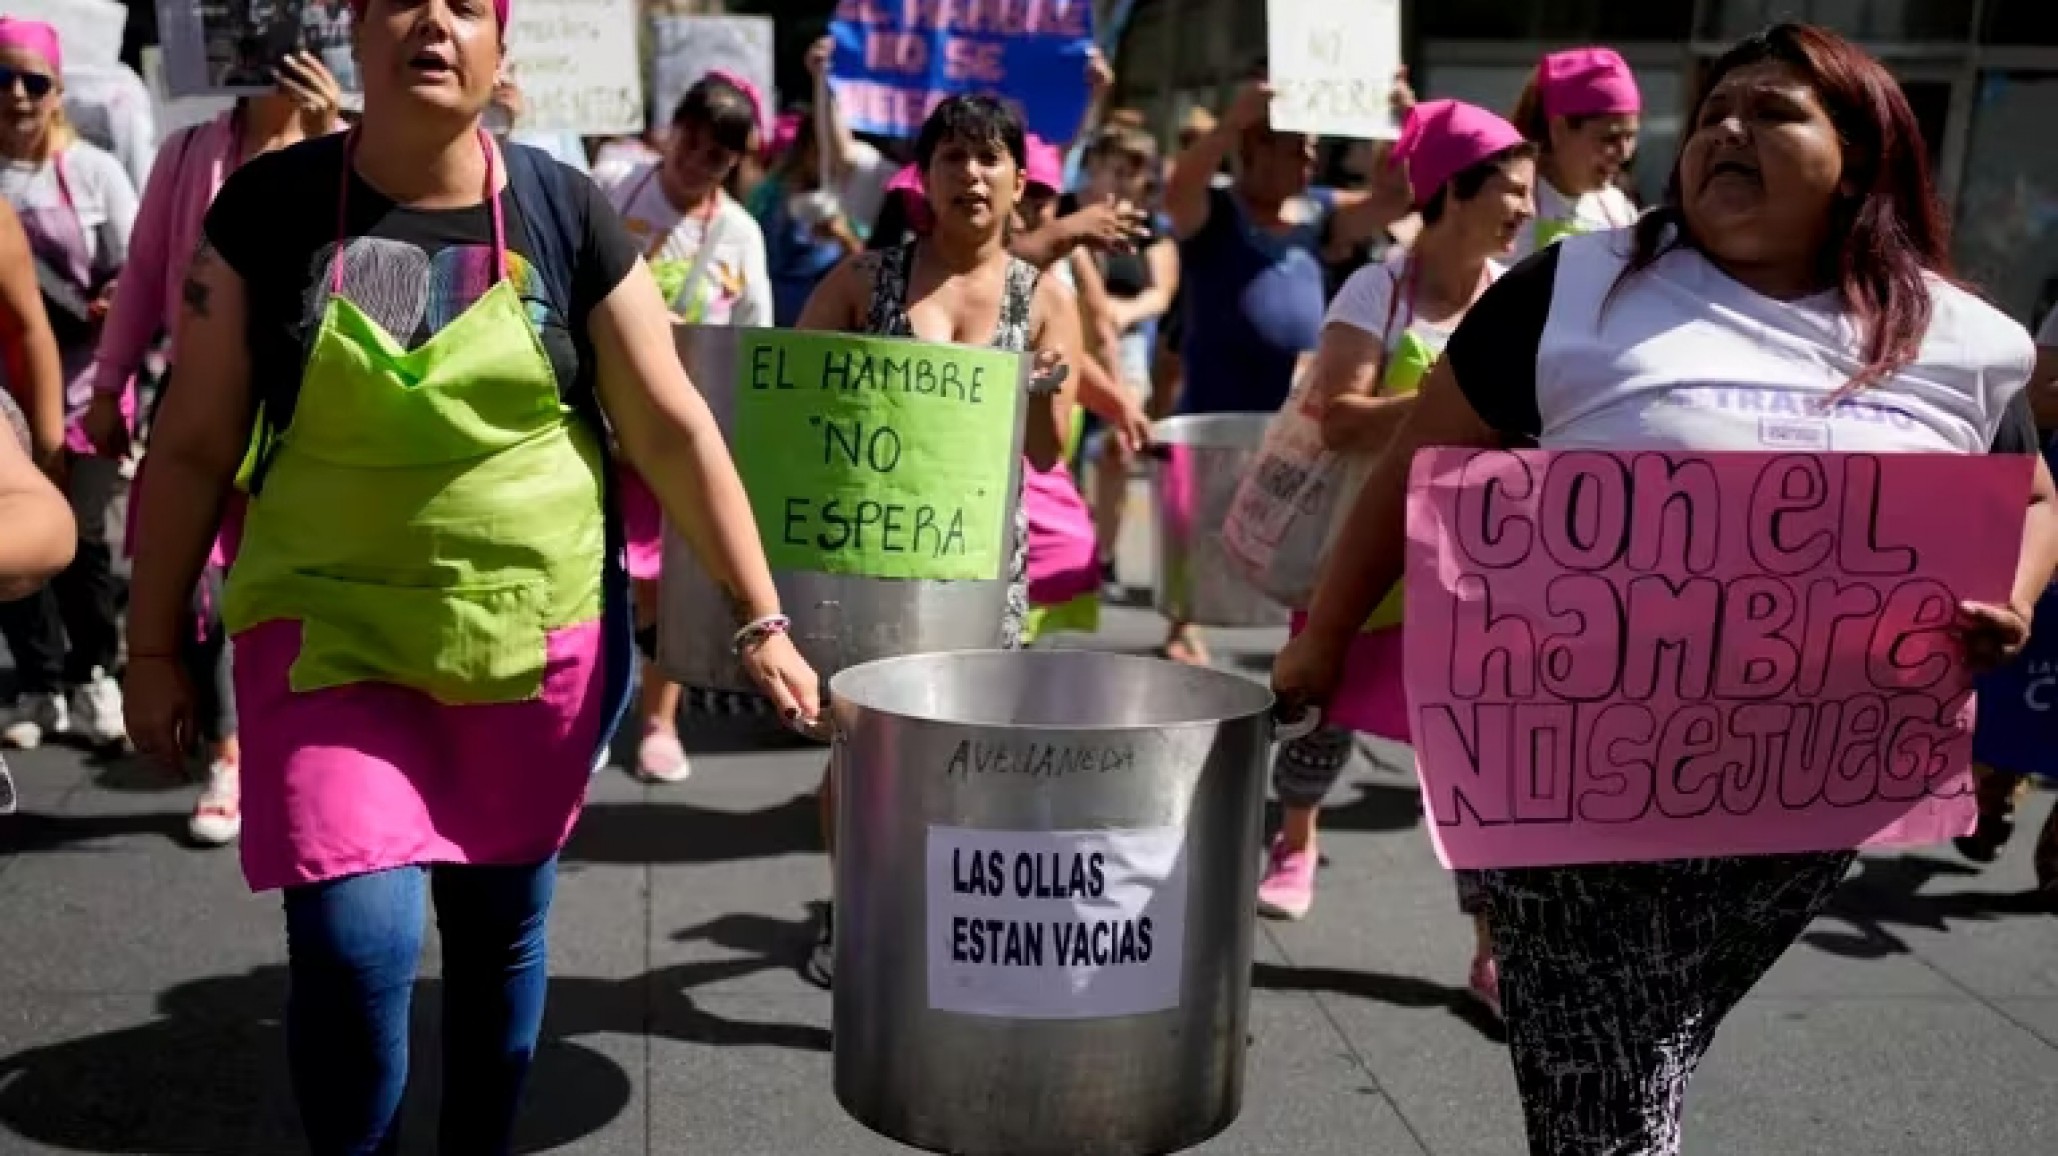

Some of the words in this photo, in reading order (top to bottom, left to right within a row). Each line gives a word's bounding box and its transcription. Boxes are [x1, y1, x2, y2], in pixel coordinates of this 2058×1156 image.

[752, 346, 795, 390] EL
[821, 350, 985, 404] HAMBRE
[952, 847, 1006, 897] LAS
[1013, 851, 1106, 899] OLLAS
[951, 917, 1044, 967] ESTAN
[1052, 916, 1154, 967] VACIAS
